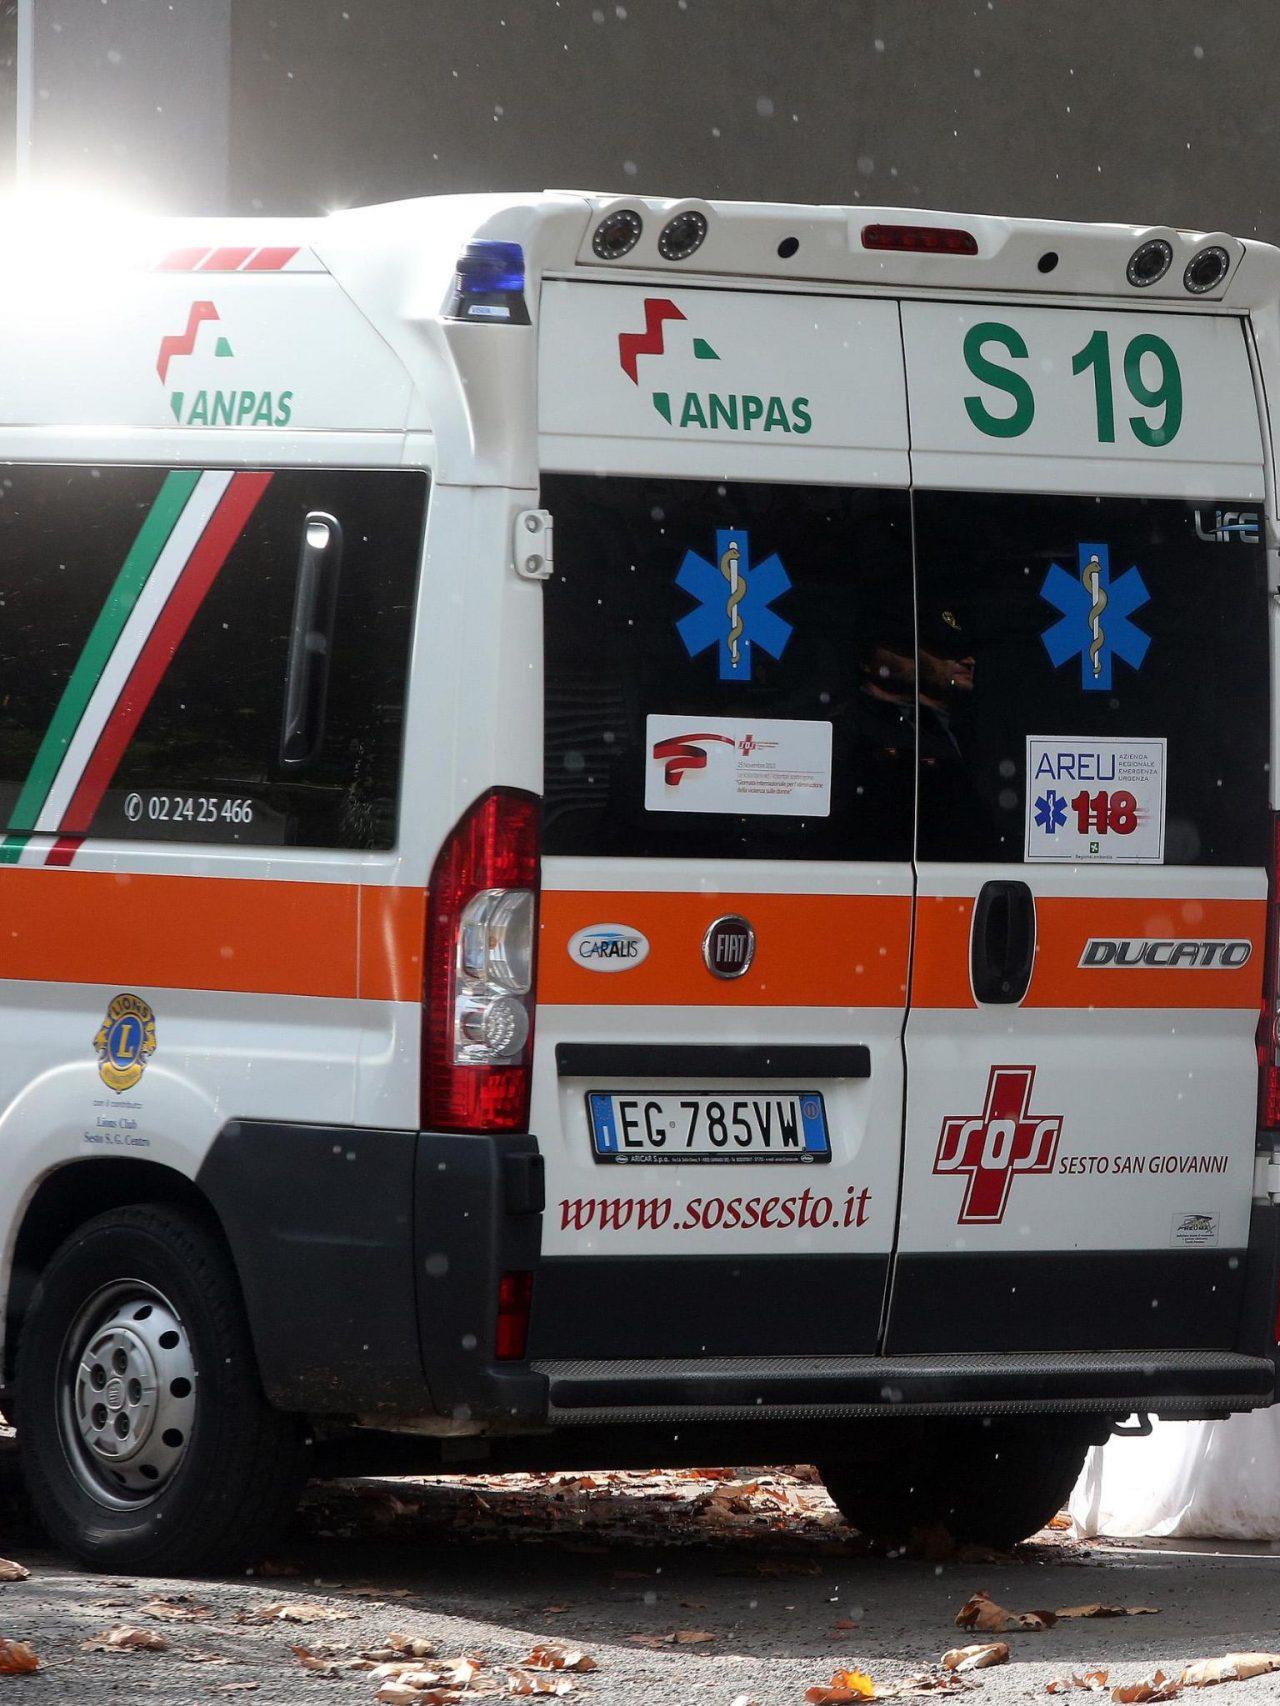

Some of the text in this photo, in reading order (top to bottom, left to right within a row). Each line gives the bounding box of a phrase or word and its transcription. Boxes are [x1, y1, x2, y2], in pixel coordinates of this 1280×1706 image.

[963, 321, 1183, 447] S 19
[187, 390, 294, 427] ANPAS
[680, 392, 812, 435] ANPAS
[1035, 753, 1115, 780] AREU
[148, 796, 253, 823] 02 24 25 466
[1071, 790, 1138, 835] 118
[579, 939, 640, 958] CARALIS
[716, 934, 747, 963] FIAT
[1081, 941, 1252, 966] DUCATO
[117, 1024, 133, 1058] L
[619, 1101, 667, 1147] EG
[680, 1101, 800, 1147] 785VW
[937, 1118, 1060, 1170] SOS
[1059, 1155, 1229, 1174] SESTO SAN GIOVANNI
[558, 1185, 873, 1231] www.sossesto.it
